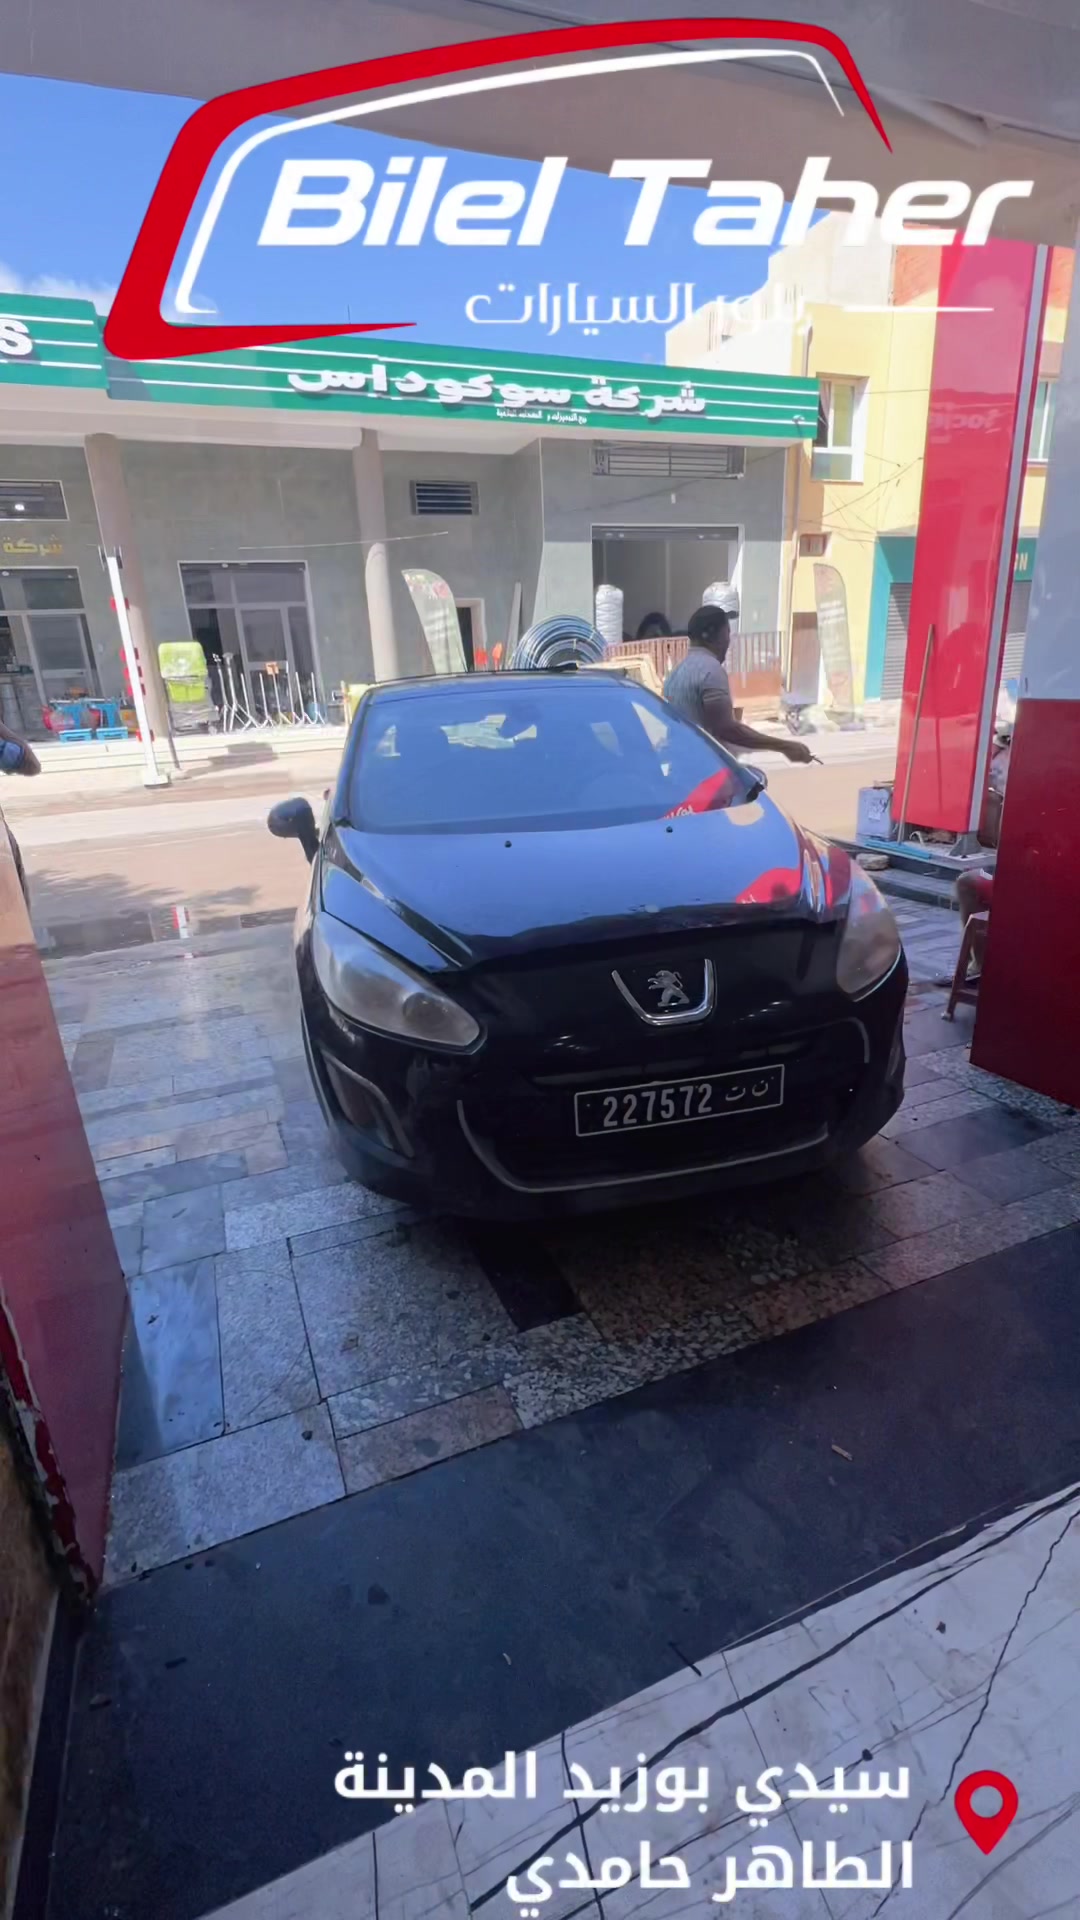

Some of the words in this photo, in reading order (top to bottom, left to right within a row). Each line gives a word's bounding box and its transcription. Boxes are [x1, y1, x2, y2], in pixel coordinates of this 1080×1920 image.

[288, 364, 571, 407] سوكوداس
[584, 376, 706, 417] شركة
[3, 534, 63, 556] شركة
[603, 1083, 713, 1128] 227572
